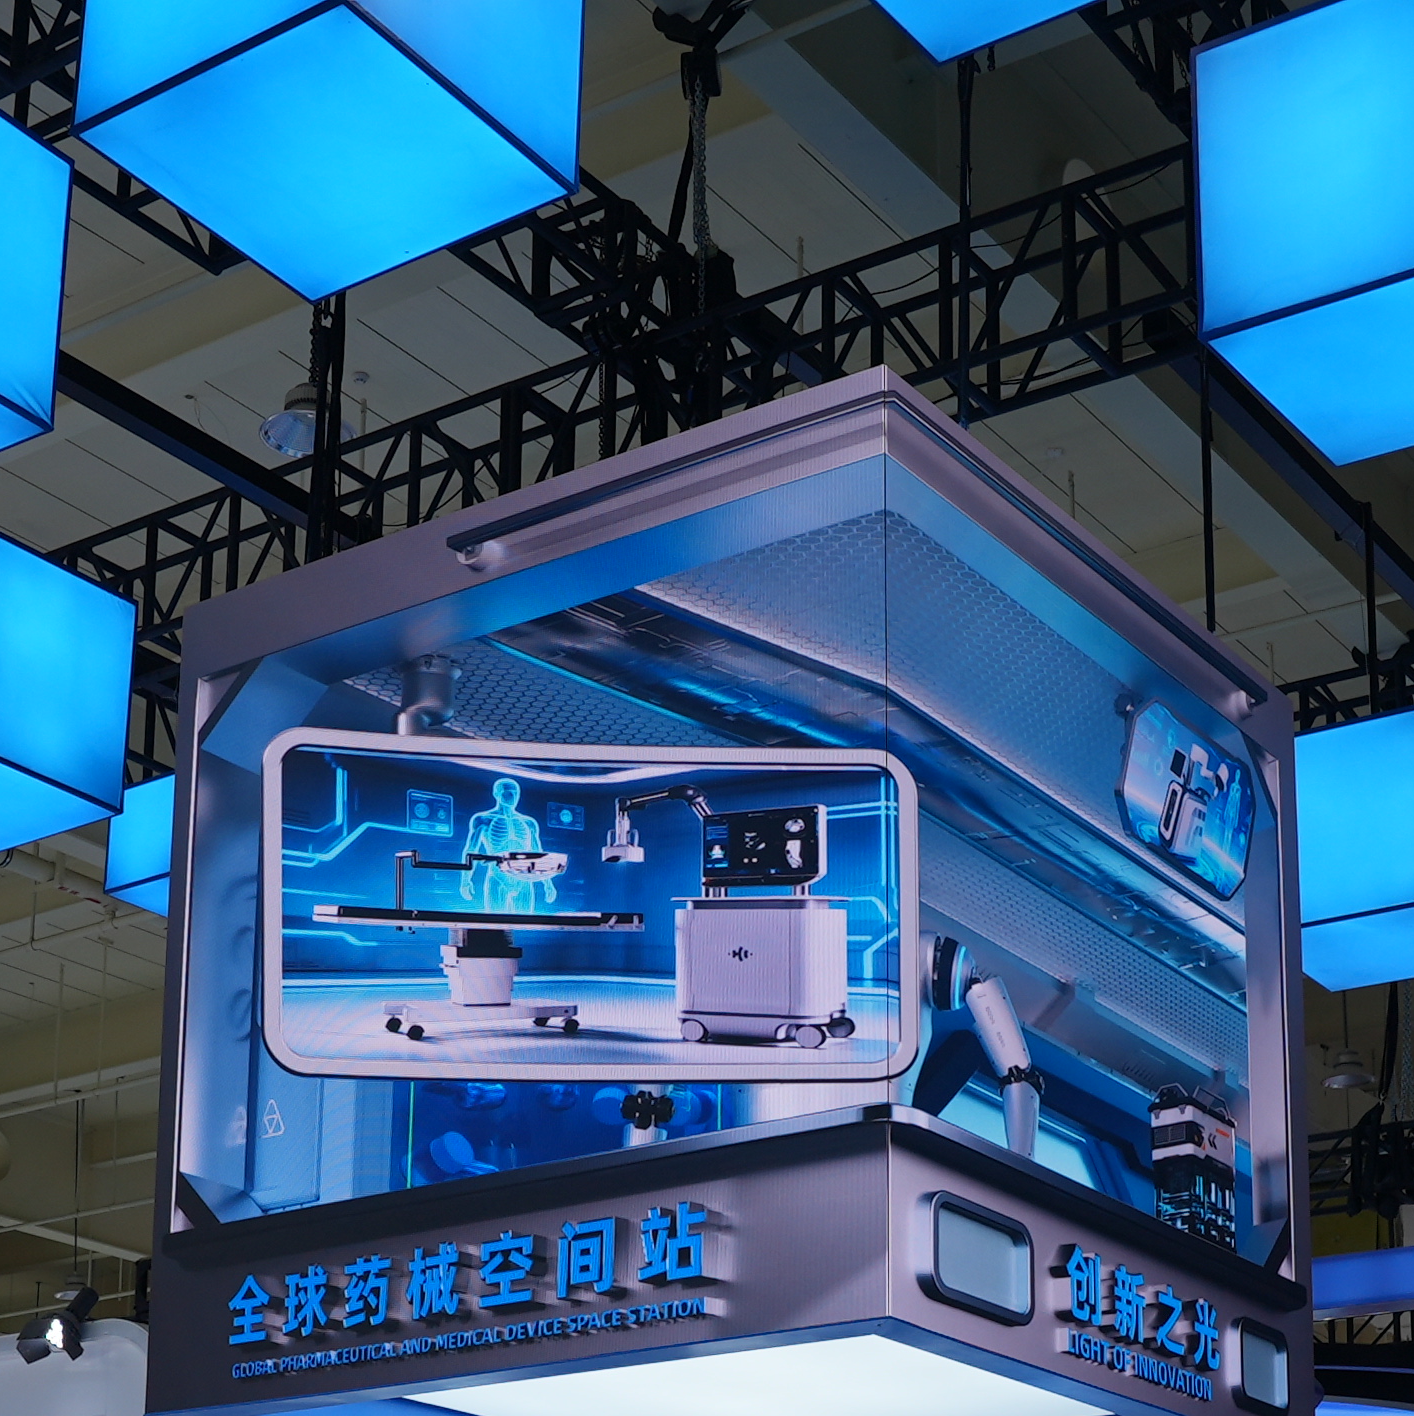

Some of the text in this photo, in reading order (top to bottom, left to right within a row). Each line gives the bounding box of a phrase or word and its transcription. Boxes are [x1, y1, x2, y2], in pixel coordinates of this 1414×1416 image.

[227, 1201, 706, 1346] 全球药械空间站
[1067, 1245, 1220, 1370] 创新之光
[231, 1298, 706, 1380] GLOBAL PHARMACEUTICAL AND MEDICAL DEVICE SPACE STATION
[1068, 1328, 1213, 1402] LIGHT OF INNOVATION
